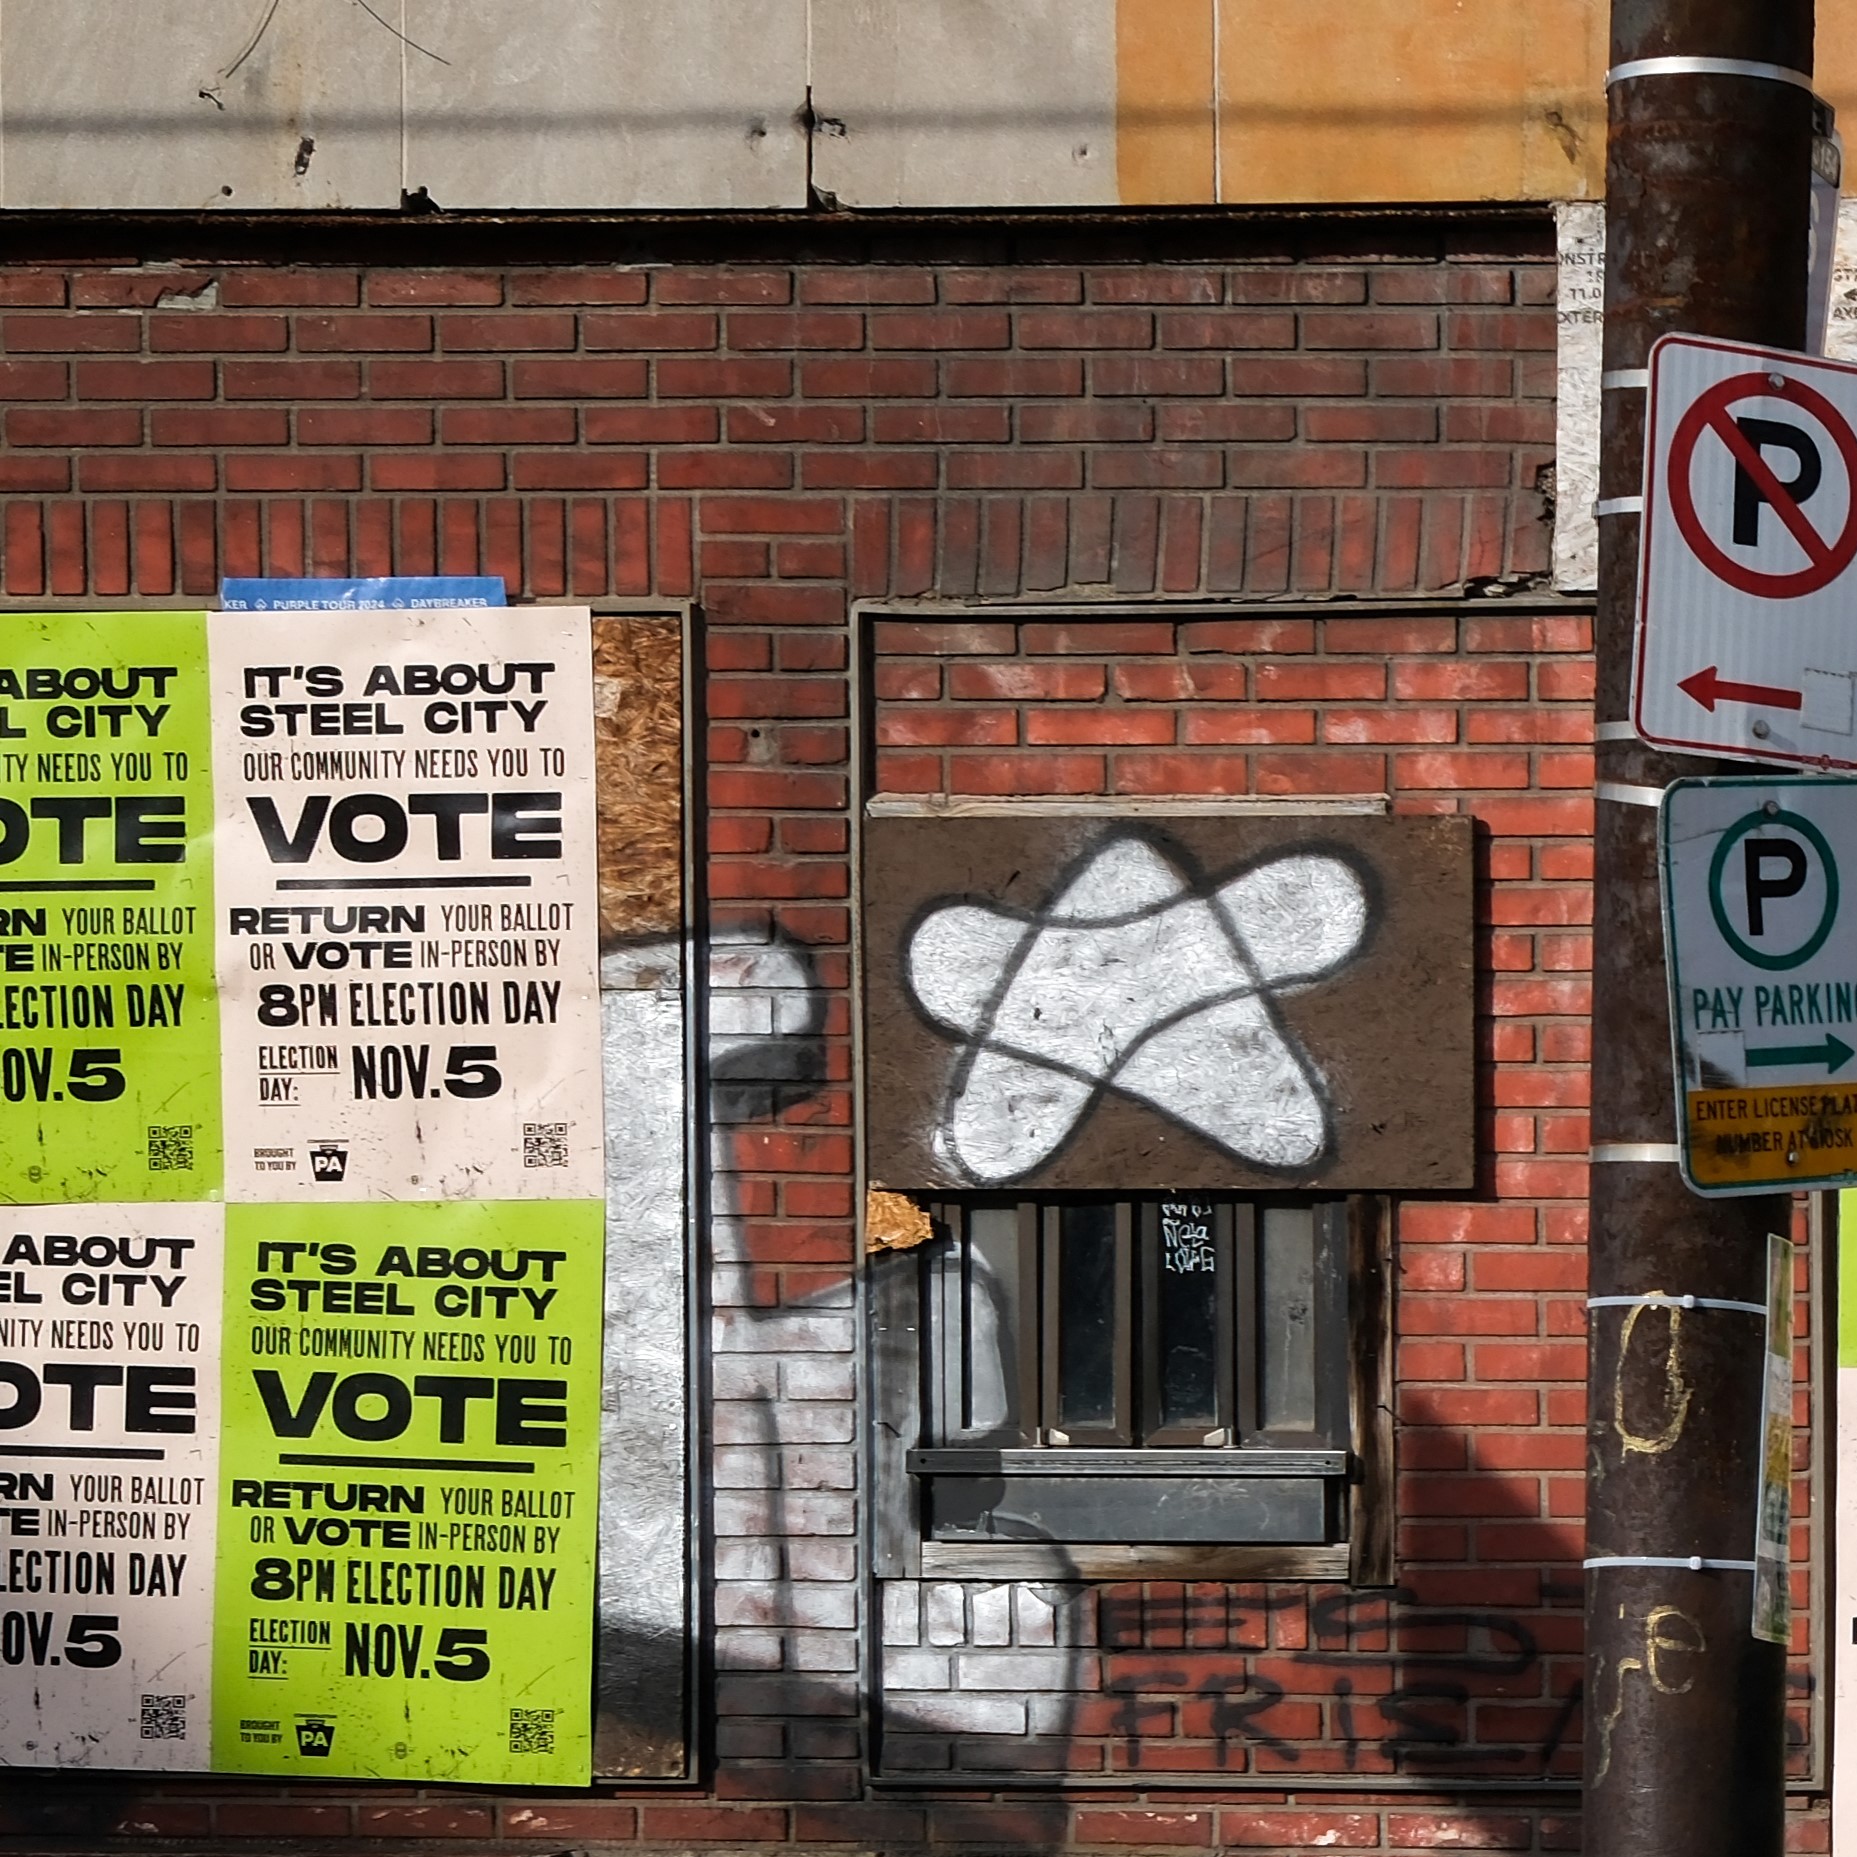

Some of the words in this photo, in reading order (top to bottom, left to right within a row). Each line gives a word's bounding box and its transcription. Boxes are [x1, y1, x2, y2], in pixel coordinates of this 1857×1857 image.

[1733, 416, 1822, 547] P
[273, 600, 318, 610] PURPLE
[321, 600, 355, 610] TOUR
[358, 600, 385, 610] 2024
[411, 598, 487, 608] DAYBREAKER
[0, 667, 177, 699] ABOUT
[244, 666, 343, 698] IT'S
[363, 663, 555, 696] ABOUT
[47, 705, 170, 738] CITY
[241, 703, 403, 737] STEEL
[424, 701, 548, 734] CITY
[246, 792, 562, 863] VOTE
[1744, 838, 1808, 936] P
[42, 943, 149, 971] IN-PERSON
[157, 943, 182, 970] BY
[1694, 986, 1744, 1030] PAY
[1696, 1099, 1748, 1121] ENTER
[1754, 1096, 1816, 1118] LICENSE
[1715, 1132, 1784, 1154] NUMBER
[1789, 1130, 1807, 1150] AT
[1809, 1128, 1854, 1149] KIOSK
[314, 1156, 343, 1172] PA
[52, 1320, 113, 1349] NEEDS
[124, 1322, 163, 1351] YOU
[176, 1323, 199, 1352] TO
[70, 1475, 122, 1502] YOUR
[132, 1477, 204, 1505] BALLOT
[232, 1480, 424, 1513] RETURN
[441, 1488, 492, 1516] YOUR
[502, 1490, 575, 1518] BALLOT
[346, 1623, 490, 1681] NOV.5
